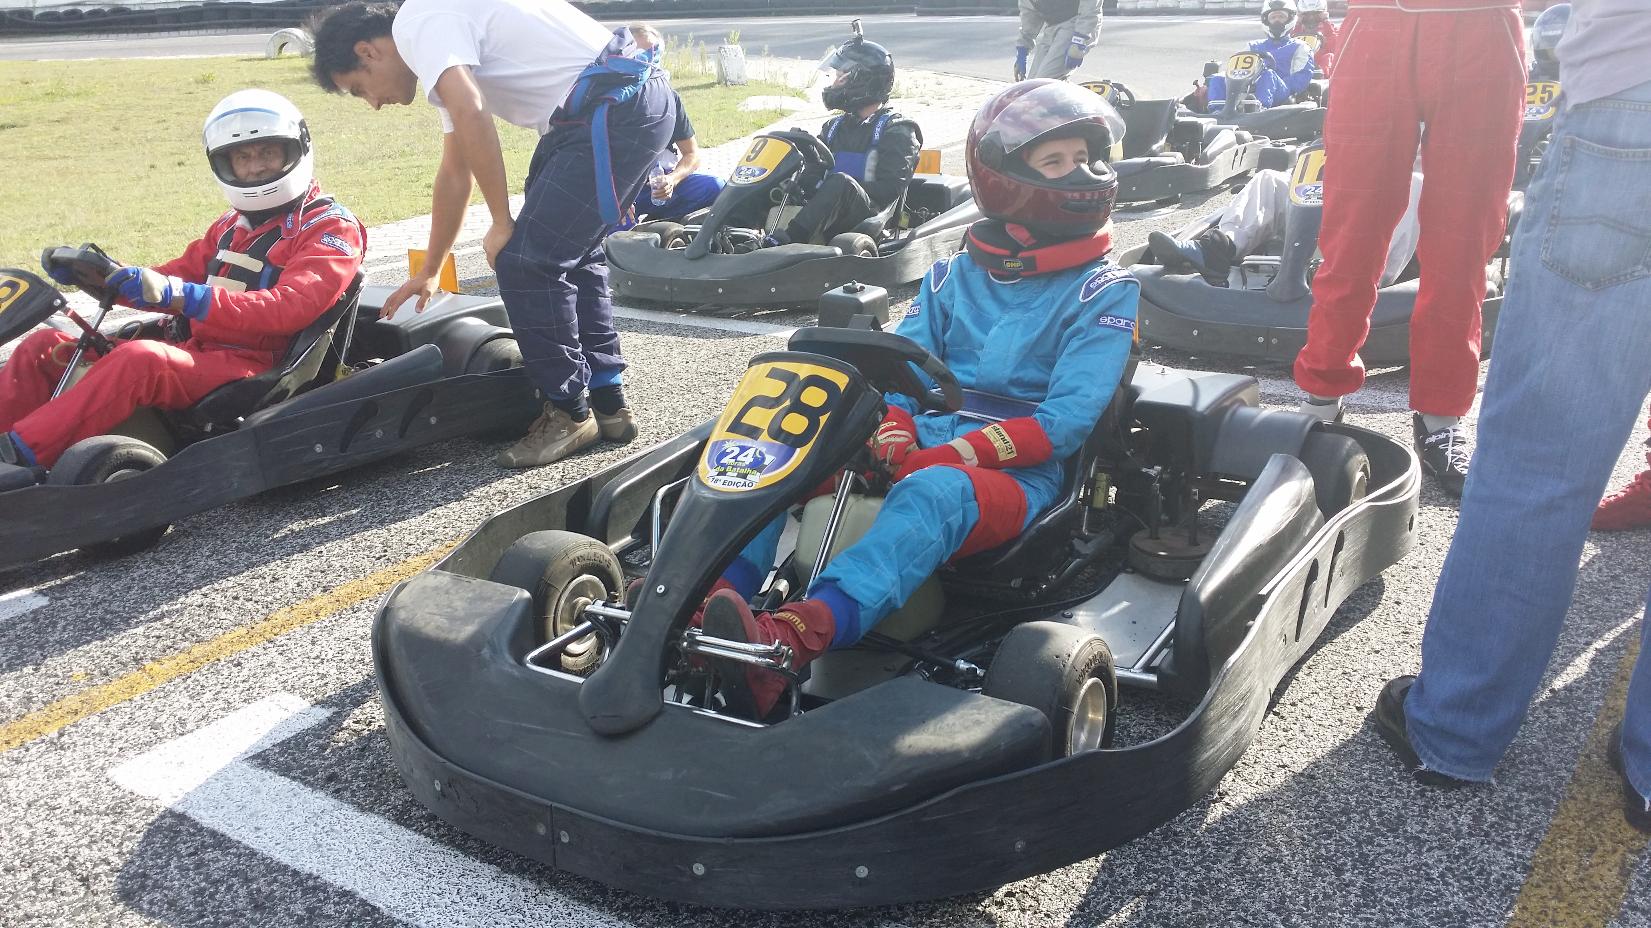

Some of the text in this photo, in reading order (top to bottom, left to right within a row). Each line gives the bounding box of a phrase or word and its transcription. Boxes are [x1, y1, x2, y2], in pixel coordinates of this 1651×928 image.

[1234, 56, 1254, 70] 19
[1526, 84, 1554, 104] 25
[746, 138, 768, 162] 9
[725, 366, 843, 449] 28
[720, 446, 757, 465] 24
